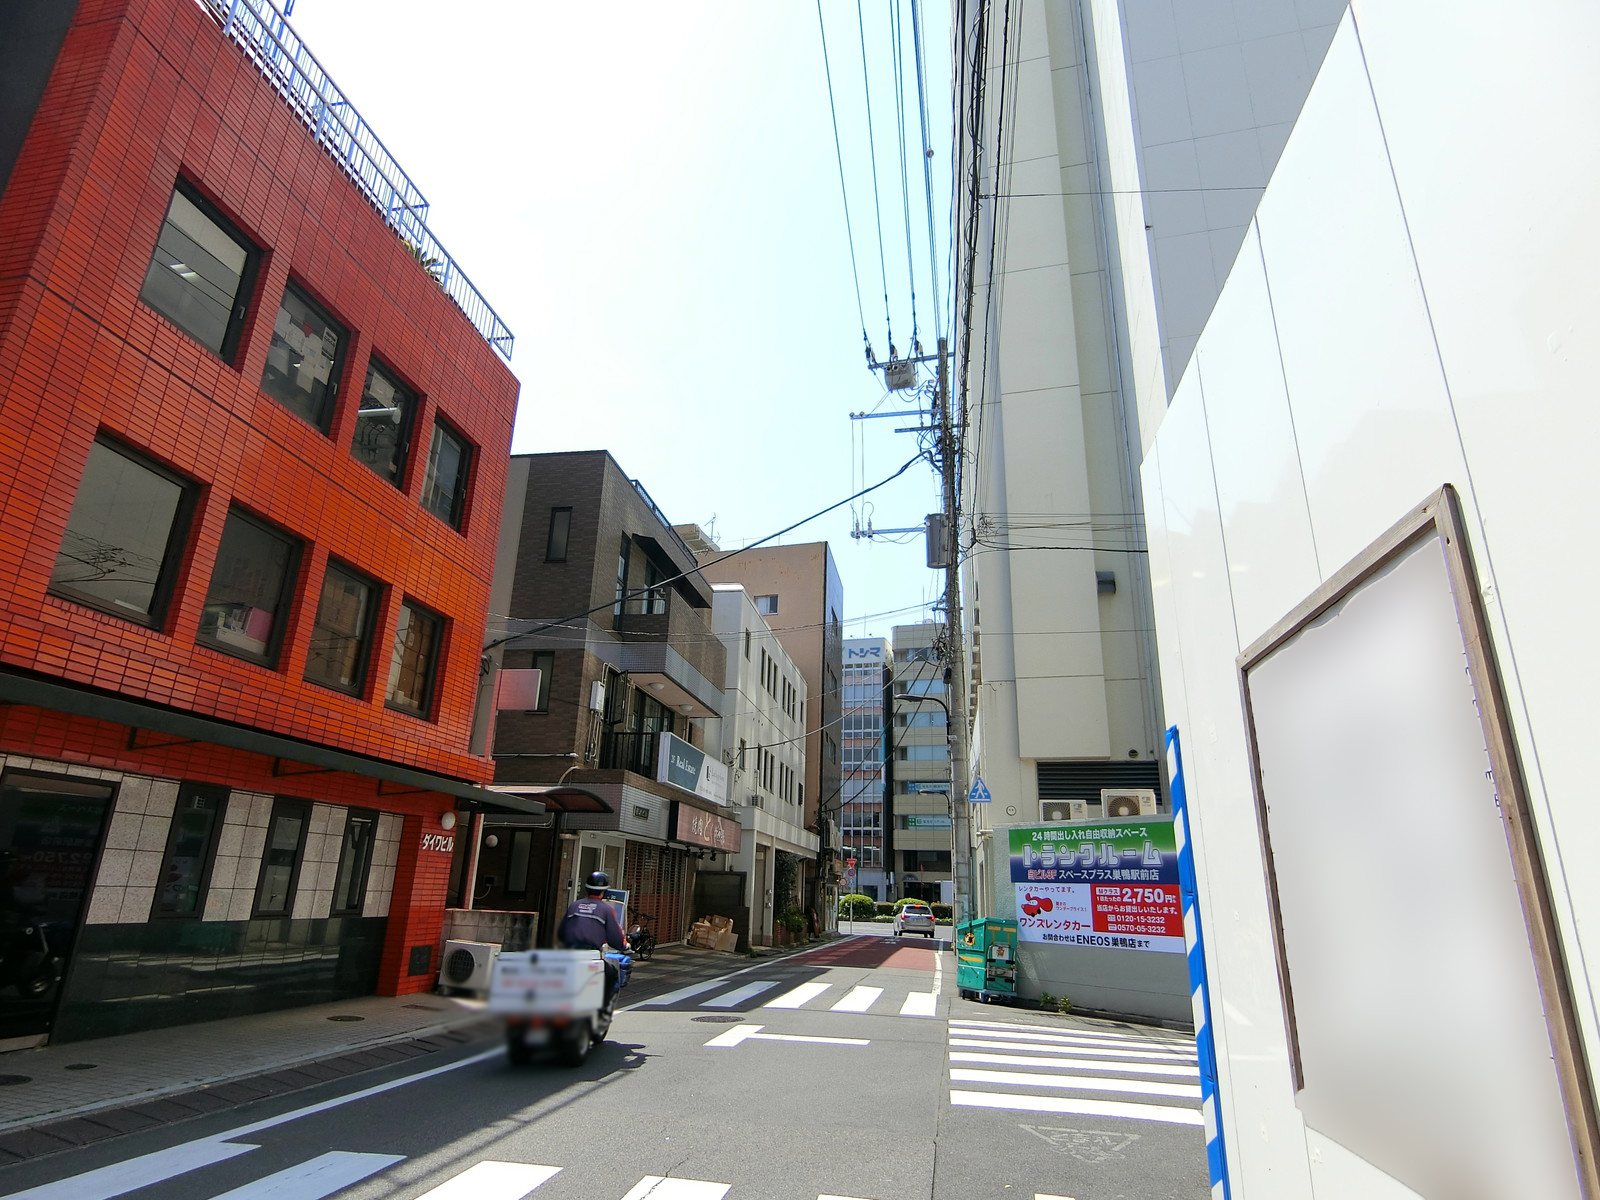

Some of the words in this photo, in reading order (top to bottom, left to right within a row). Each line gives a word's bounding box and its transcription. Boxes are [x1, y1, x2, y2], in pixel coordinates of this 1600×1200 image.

[848, 647, 880, 659] トシマ
[422, 833, 454, 852] ダイワビル
[1023, 841, 1162, 867] トランクルーム
[1019, 918, 1091, 931] ワンズレンタカー
[1117, 915, 1165, 924] 0120-15-3232
[1117, 924, 1166, 933] 0570-05-3232
[1076, 934, 1110, 947] ENEOS
